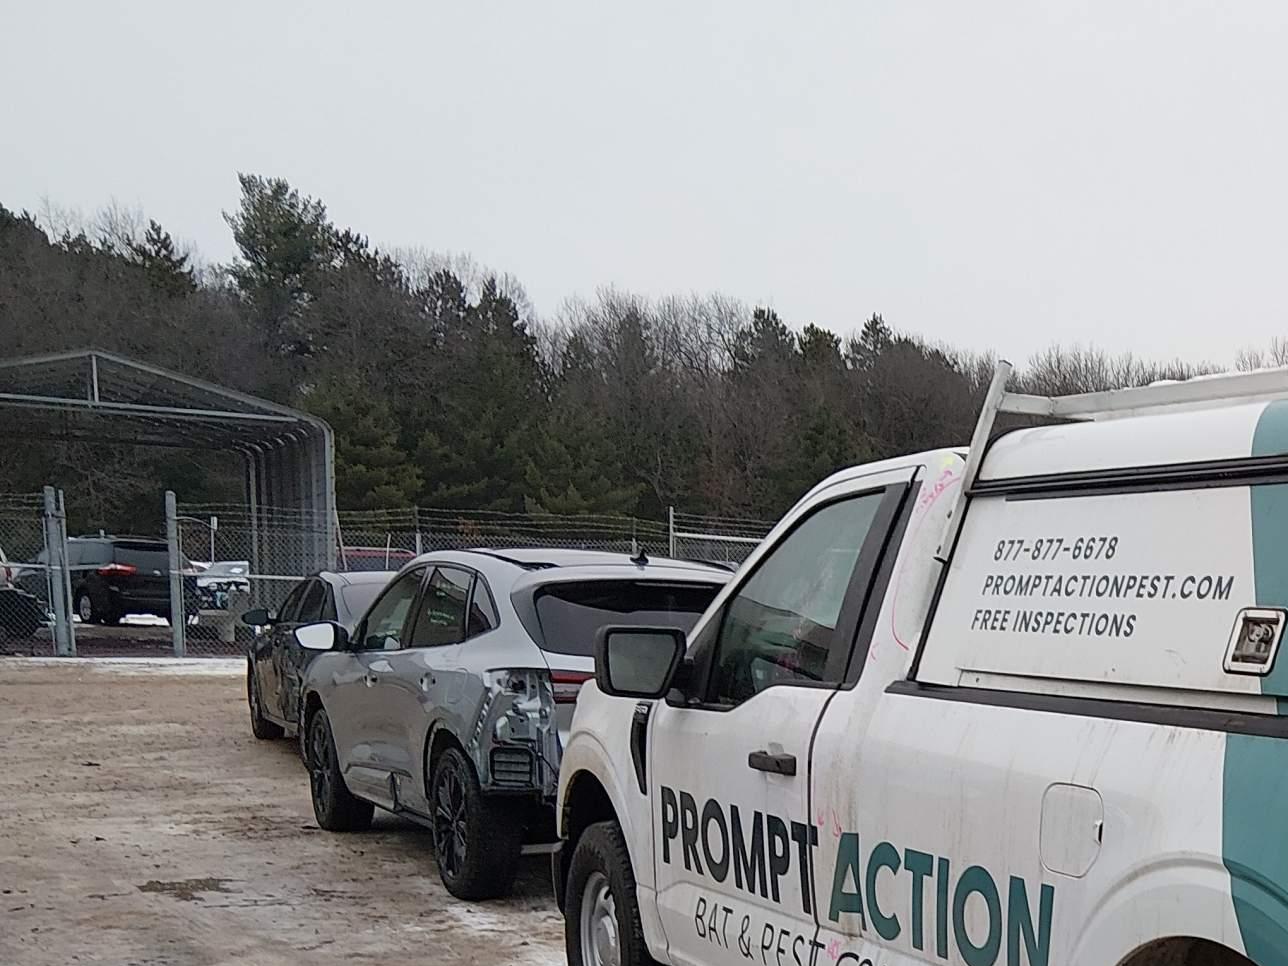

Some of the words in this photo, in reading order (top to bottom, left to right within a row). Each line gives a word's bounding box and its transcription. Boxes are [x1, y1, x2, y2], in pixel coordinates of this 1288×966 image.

[993, 536, 1119, 561] 877-877-6678
[981, 574, 1235, 600] PROMPTACTIONPEST.COM
[970, 609, 1011, 632] FREE
[1012, 610, 1137, 638] INSPECTIONS
[660, 785, 819, 915] PROMPT
[694, 896, 734, 955] BAT
[737, 915, 754, 961] &
